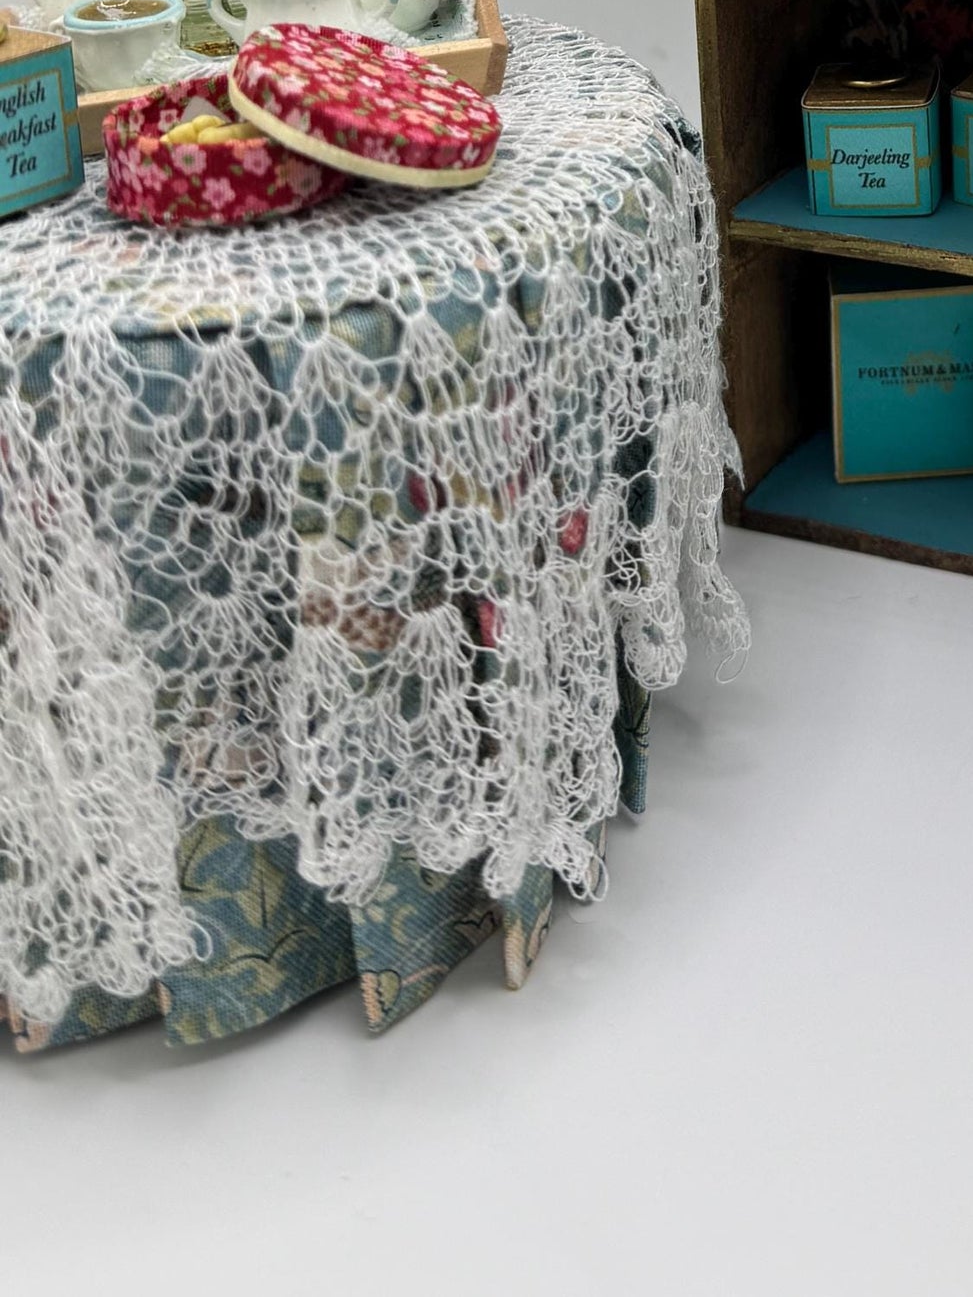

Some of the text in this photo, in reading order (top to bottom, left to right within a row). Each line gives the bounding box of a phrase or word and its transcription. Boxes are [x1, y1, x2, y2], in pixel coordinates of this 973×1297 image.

[6, 152, 37, 178] Tea
[830, 148, 911, 169] Darjeeling
[858, 172, 886, 189] Tea
